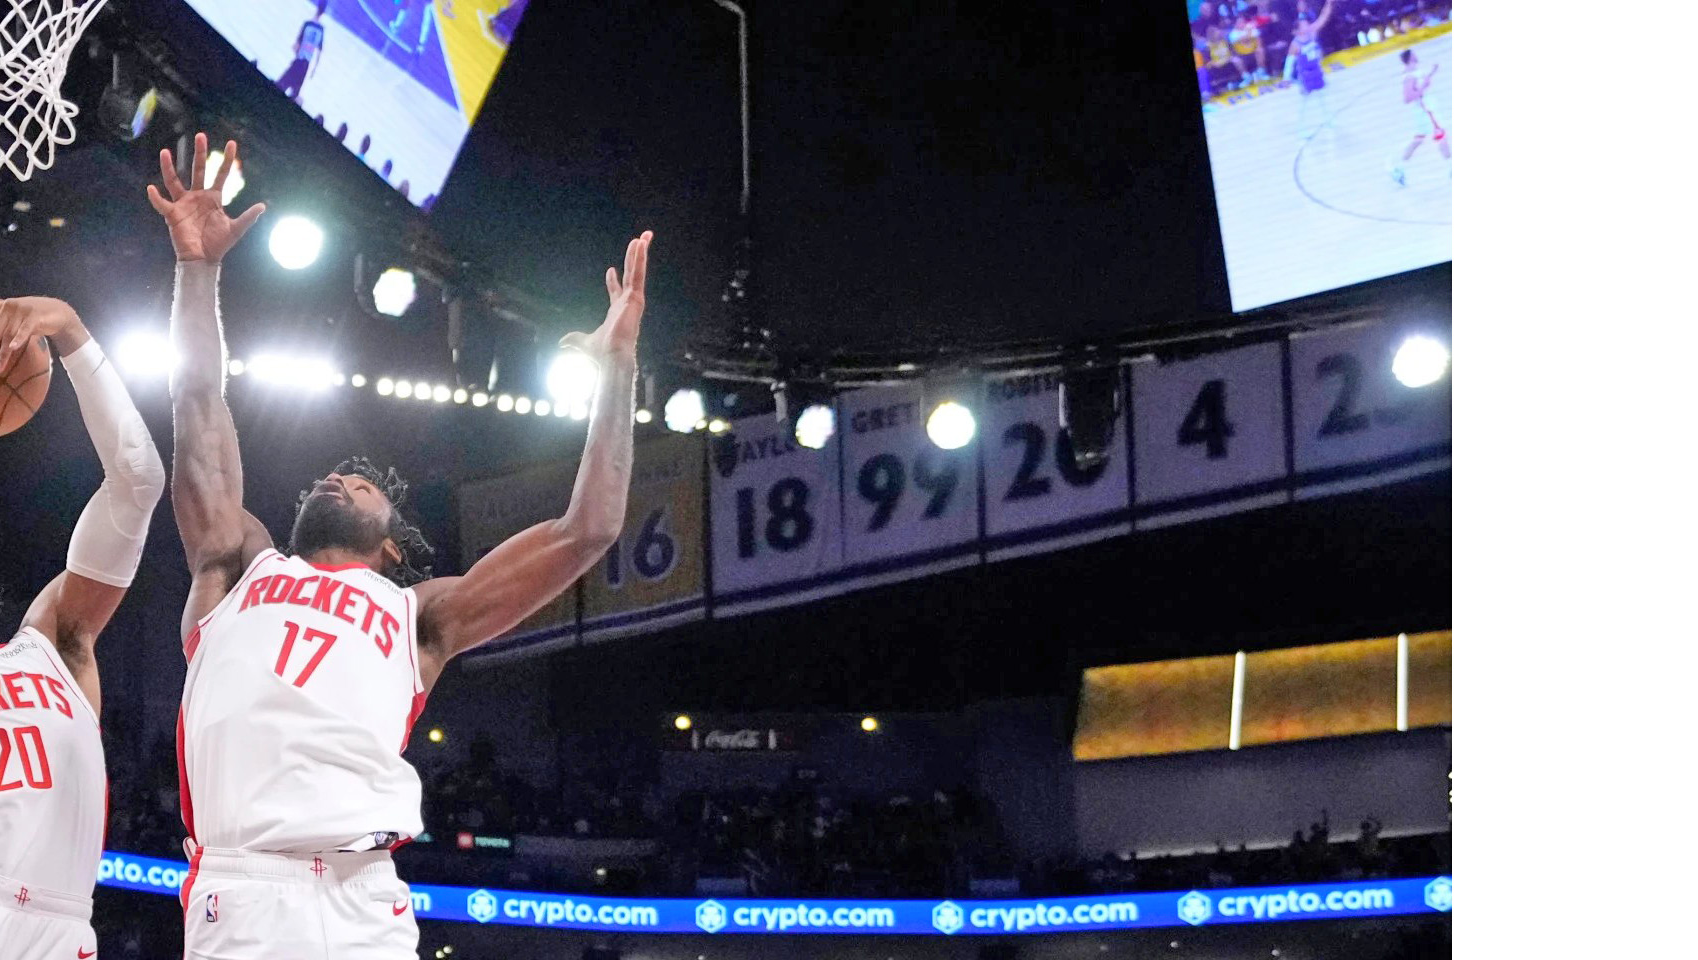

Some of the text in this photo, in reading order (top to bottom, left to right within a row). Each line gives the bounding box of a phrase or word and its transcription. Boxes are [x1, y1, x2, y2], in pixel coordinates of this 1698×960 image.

[1177, 379, 1234, 459] 4
[736, 477, 814, 559] 18
[858, 453, 958, 533] 99
[238, 574, 400, 659] ROCKETS
[274, 620, 337, 688] 17
[504, 899, 658, 926] crypto.com
[733, 904, 894, 931] crypto.com
[970, 902, 1138, 930] crypto.com
[1218, 888, 1393, 918] crypto.com
